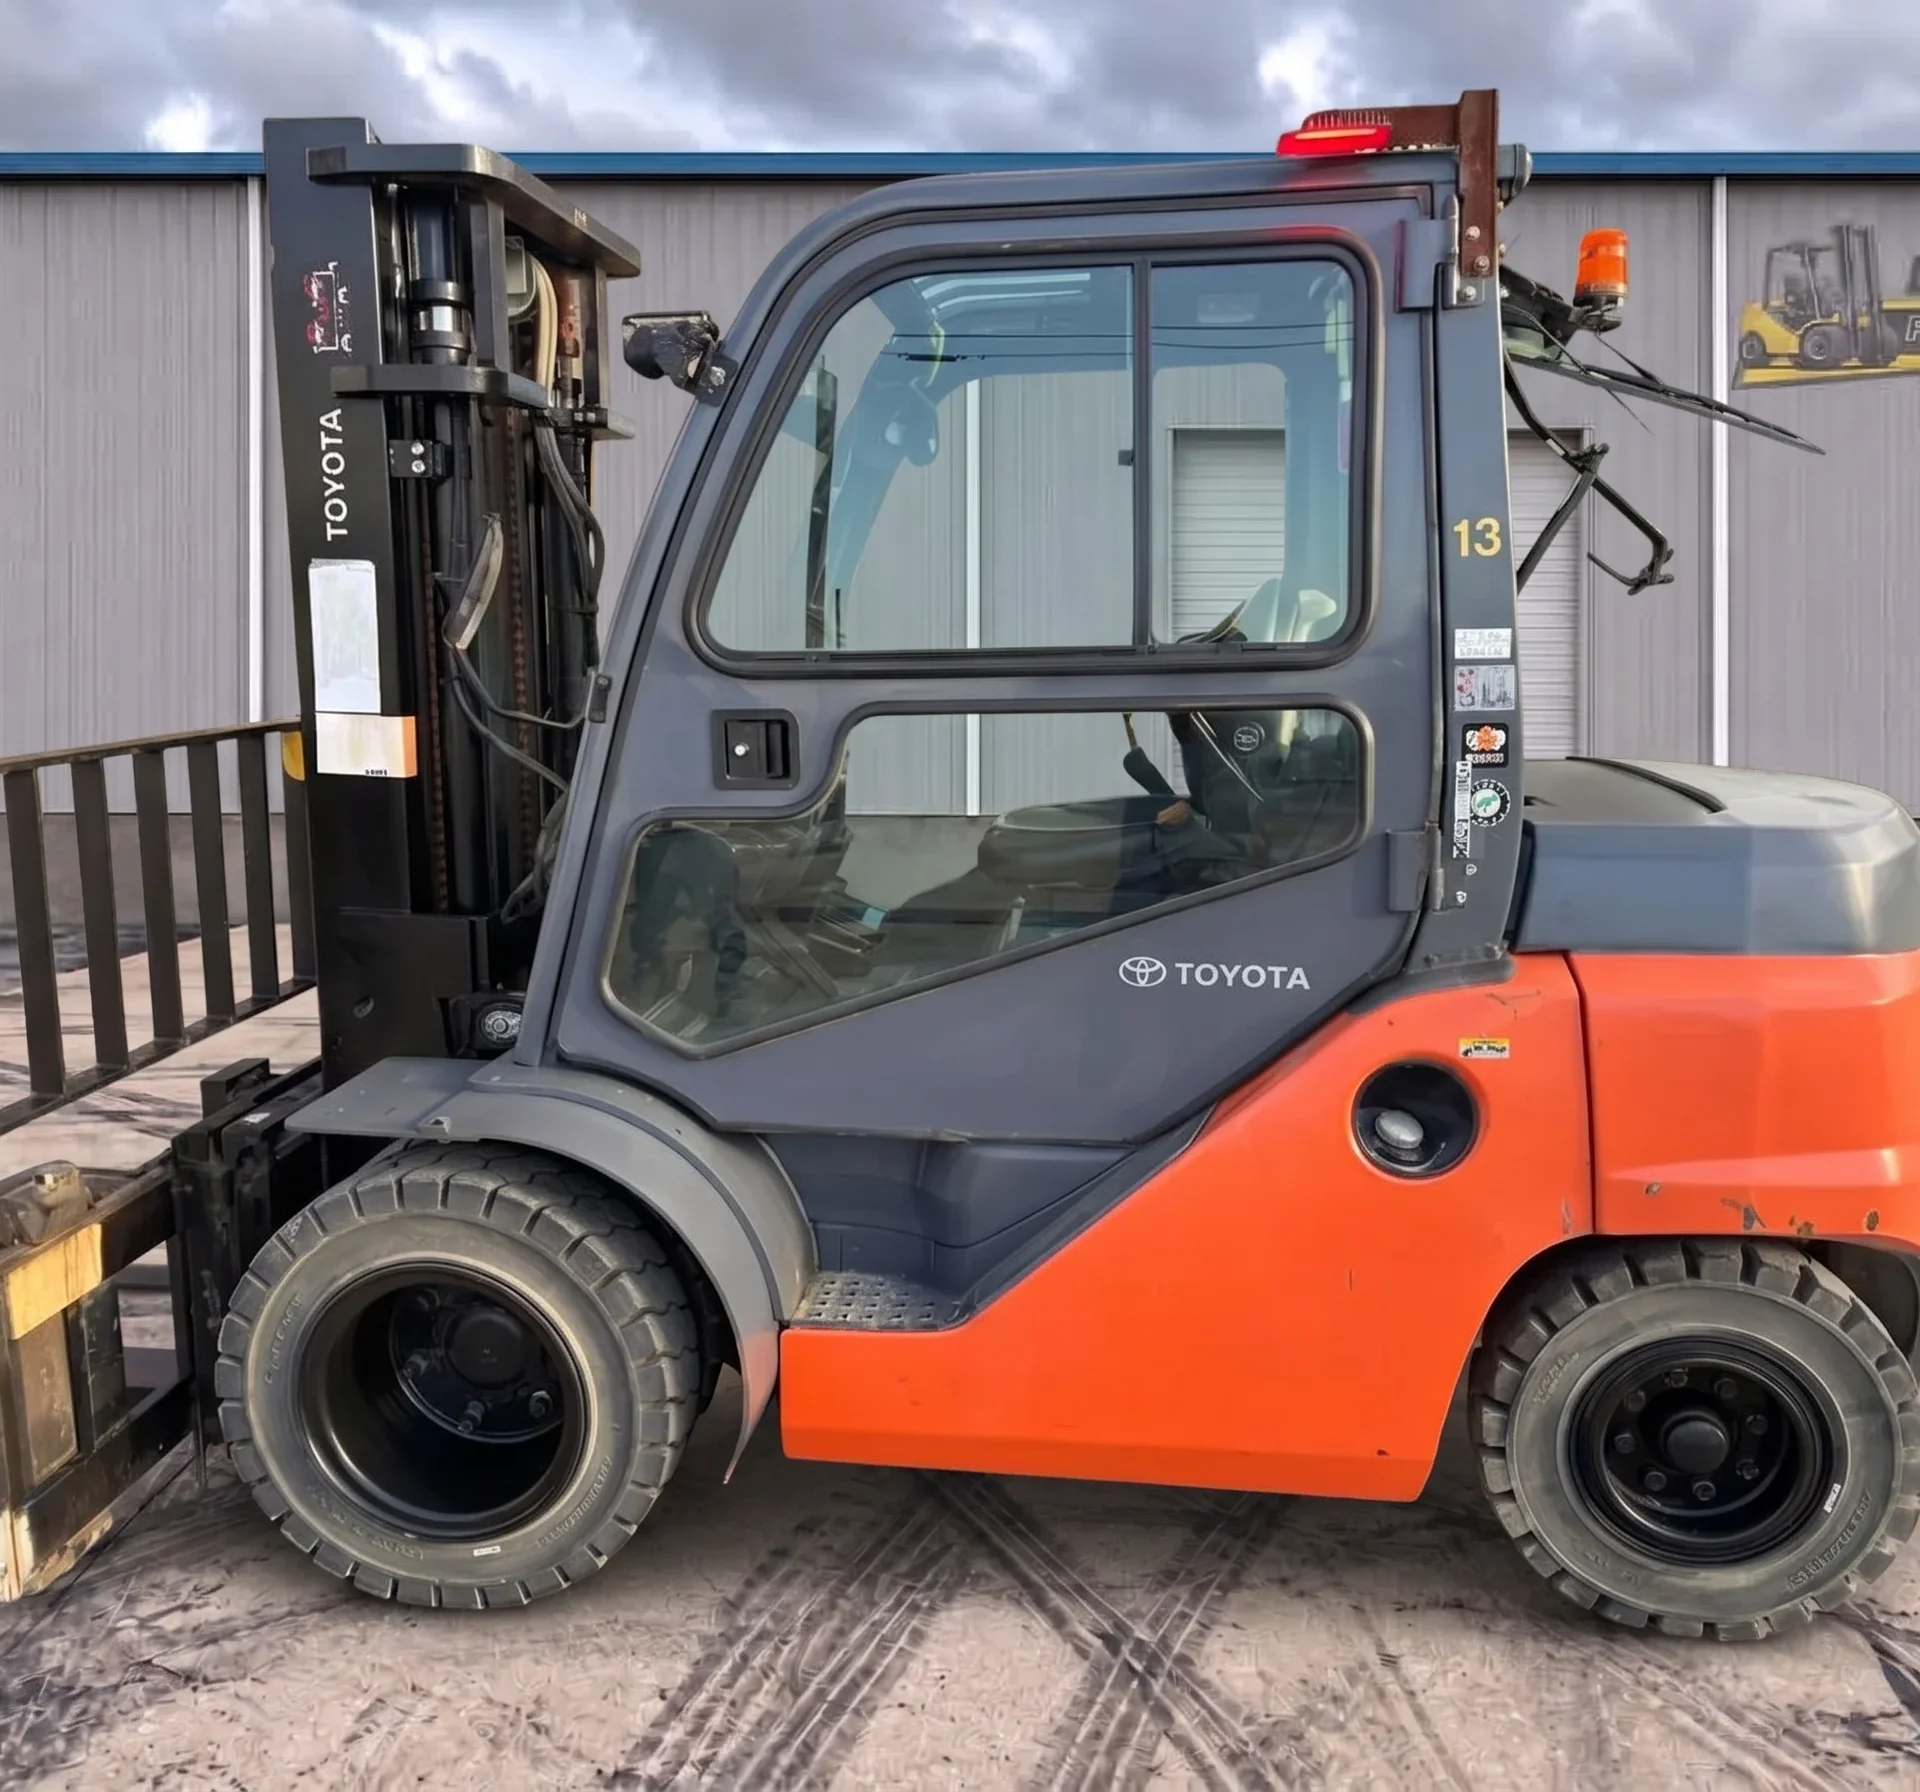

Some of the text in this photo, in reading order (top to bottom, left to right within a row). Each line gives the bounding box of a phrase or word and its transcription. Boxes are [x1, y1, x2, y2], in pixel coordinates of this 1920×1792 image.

[319, 408, 348, 542] TOYOTA
[1453, 517, 1502, 557] 13
[1175, 963, 1310, 990] TOYOTA
